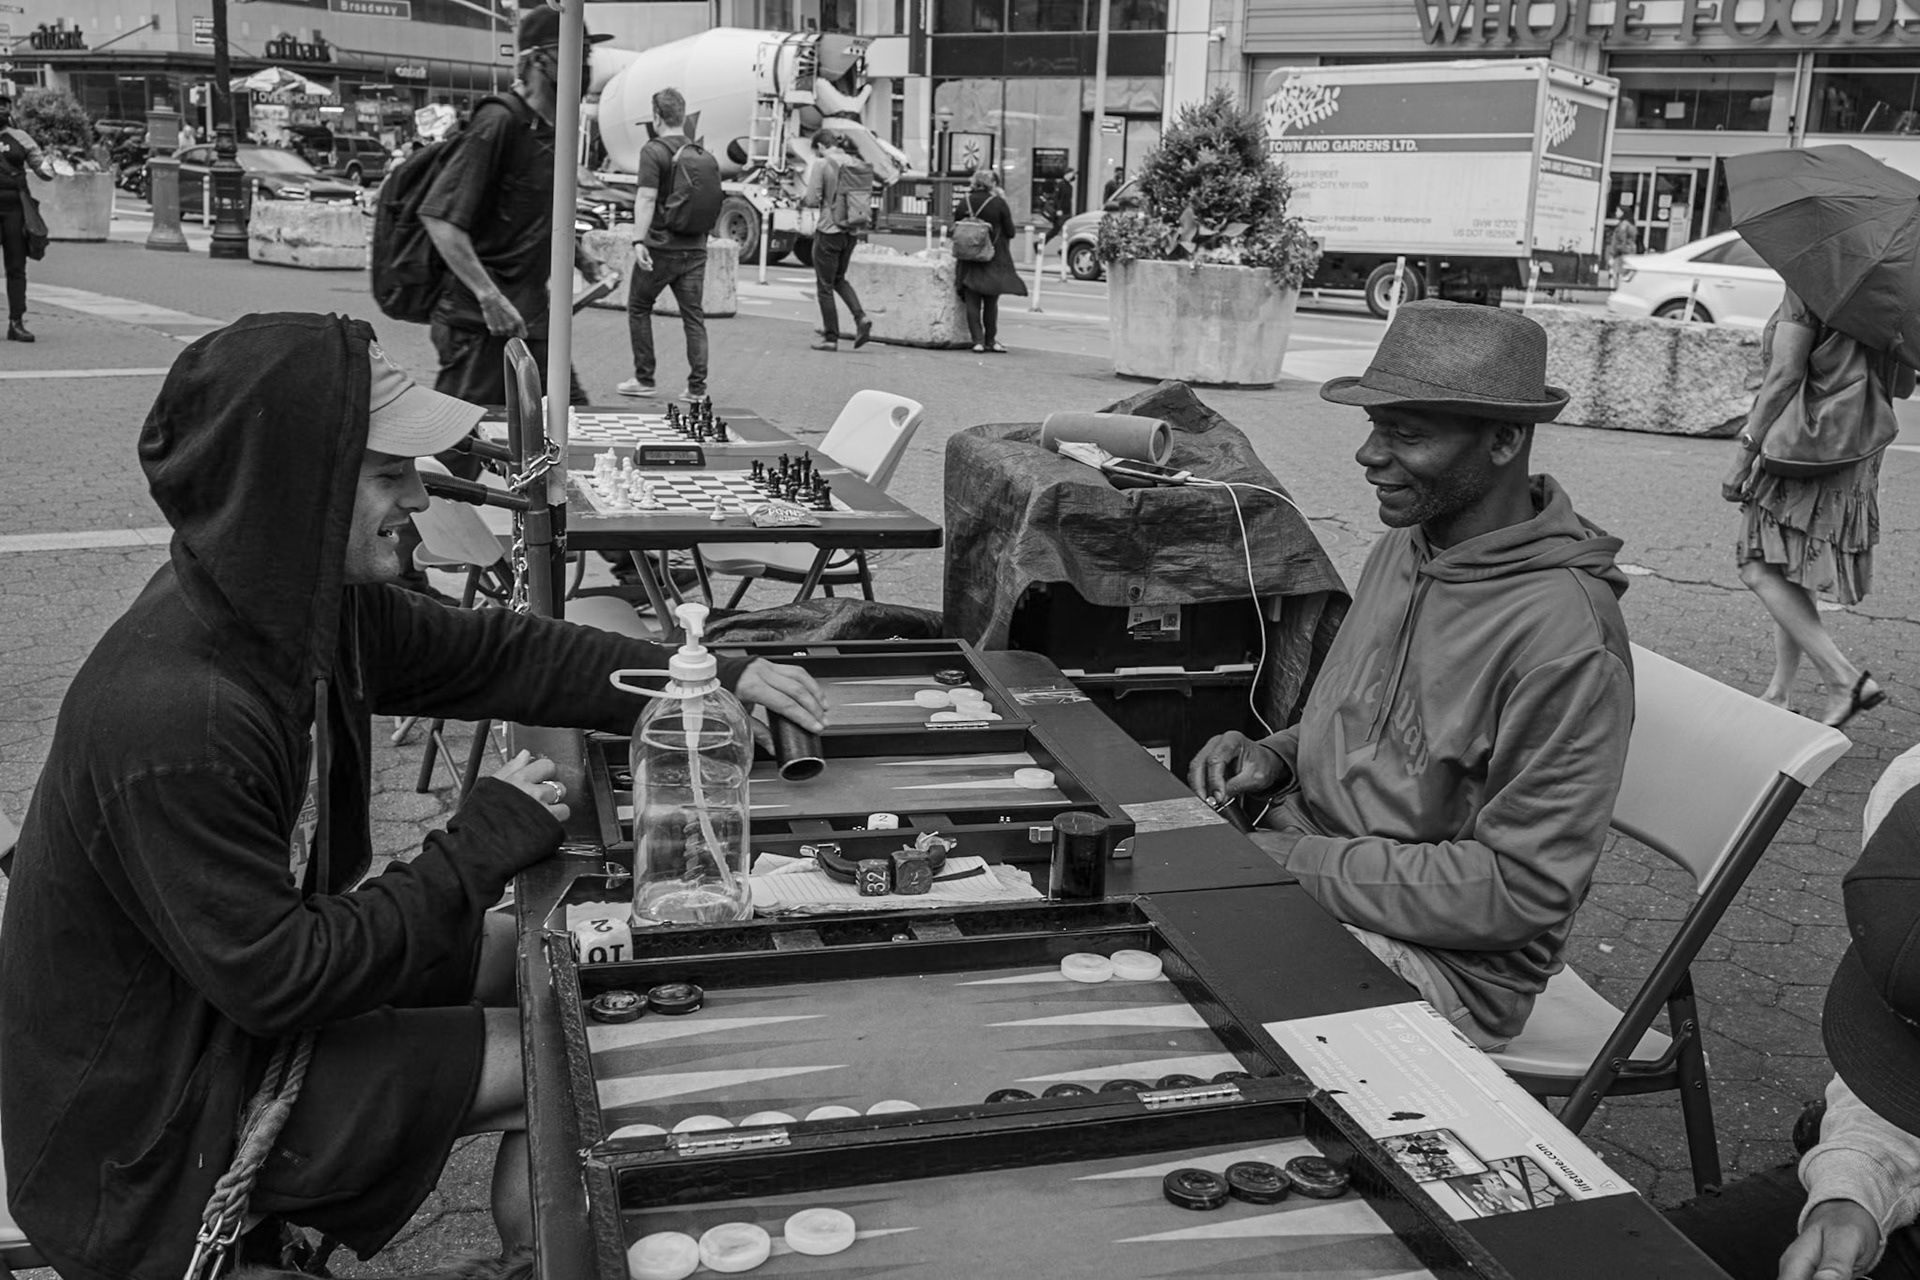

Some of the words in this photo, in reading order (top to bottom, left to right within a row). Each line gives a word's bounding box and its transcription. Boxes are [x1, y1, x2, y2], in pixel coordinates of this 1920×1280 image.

[340, 0, 398, 16] Broadway
[1416, 0, 1651, 44] WHOLE
[265, 31, 332, 62] citibank
[1269, 140, 1302, 152] TOWN
[1304, 140, 1330, 152] AND
[1332, 140, 1390, 152] GARDENS
[1392, 139, 1418, 152] LTD.
[1466, 228, 1483, 238] DOT
[878, 814, 888, 822] 2
[866, 871, 886, 893] 32
[1535, 1143, 1593, 1192] lifetime.com
